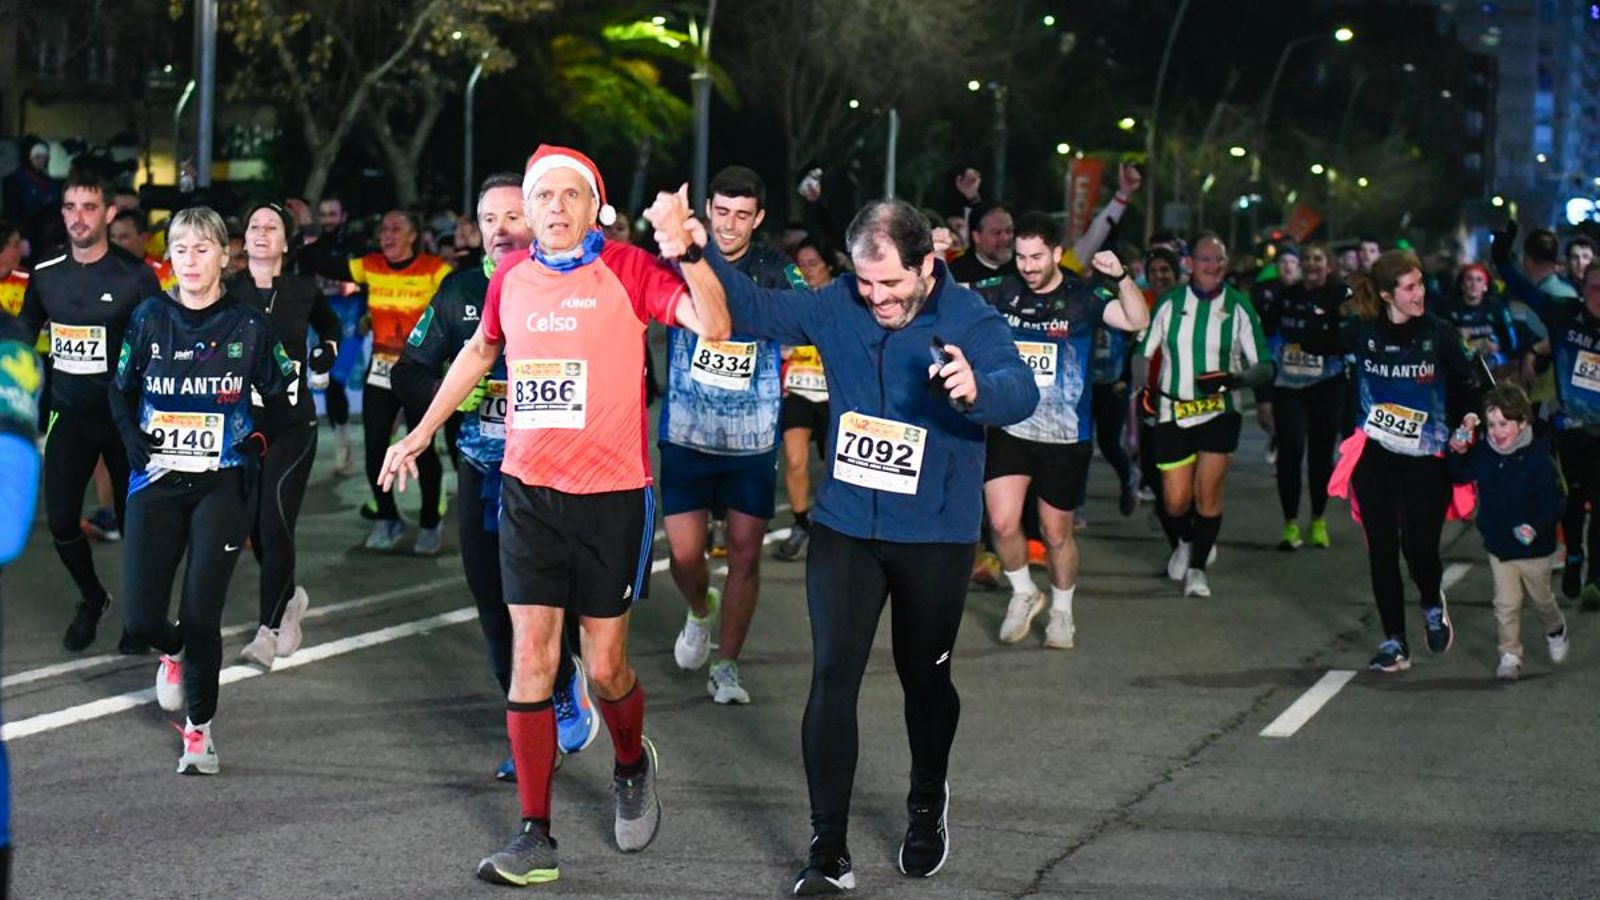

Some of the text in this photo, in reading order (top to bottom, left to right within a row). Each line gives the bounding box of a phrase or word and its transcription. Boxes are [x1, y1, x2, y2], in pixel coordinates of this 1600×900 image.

[526, 311, 578, 332] Celso
[55, 338, 99, 356] 8447
[698, 349, 752, 373] 8334
[1364, 359, 1389, 378] SAN
[181, 371, 243, 396] ANTÓN
[515, 380, 576, 403] 8366
[1374, 409, 1417, 434] 9943
[151, 428, 216, 449] 9140
[844, 432, 913, 467] 7092
